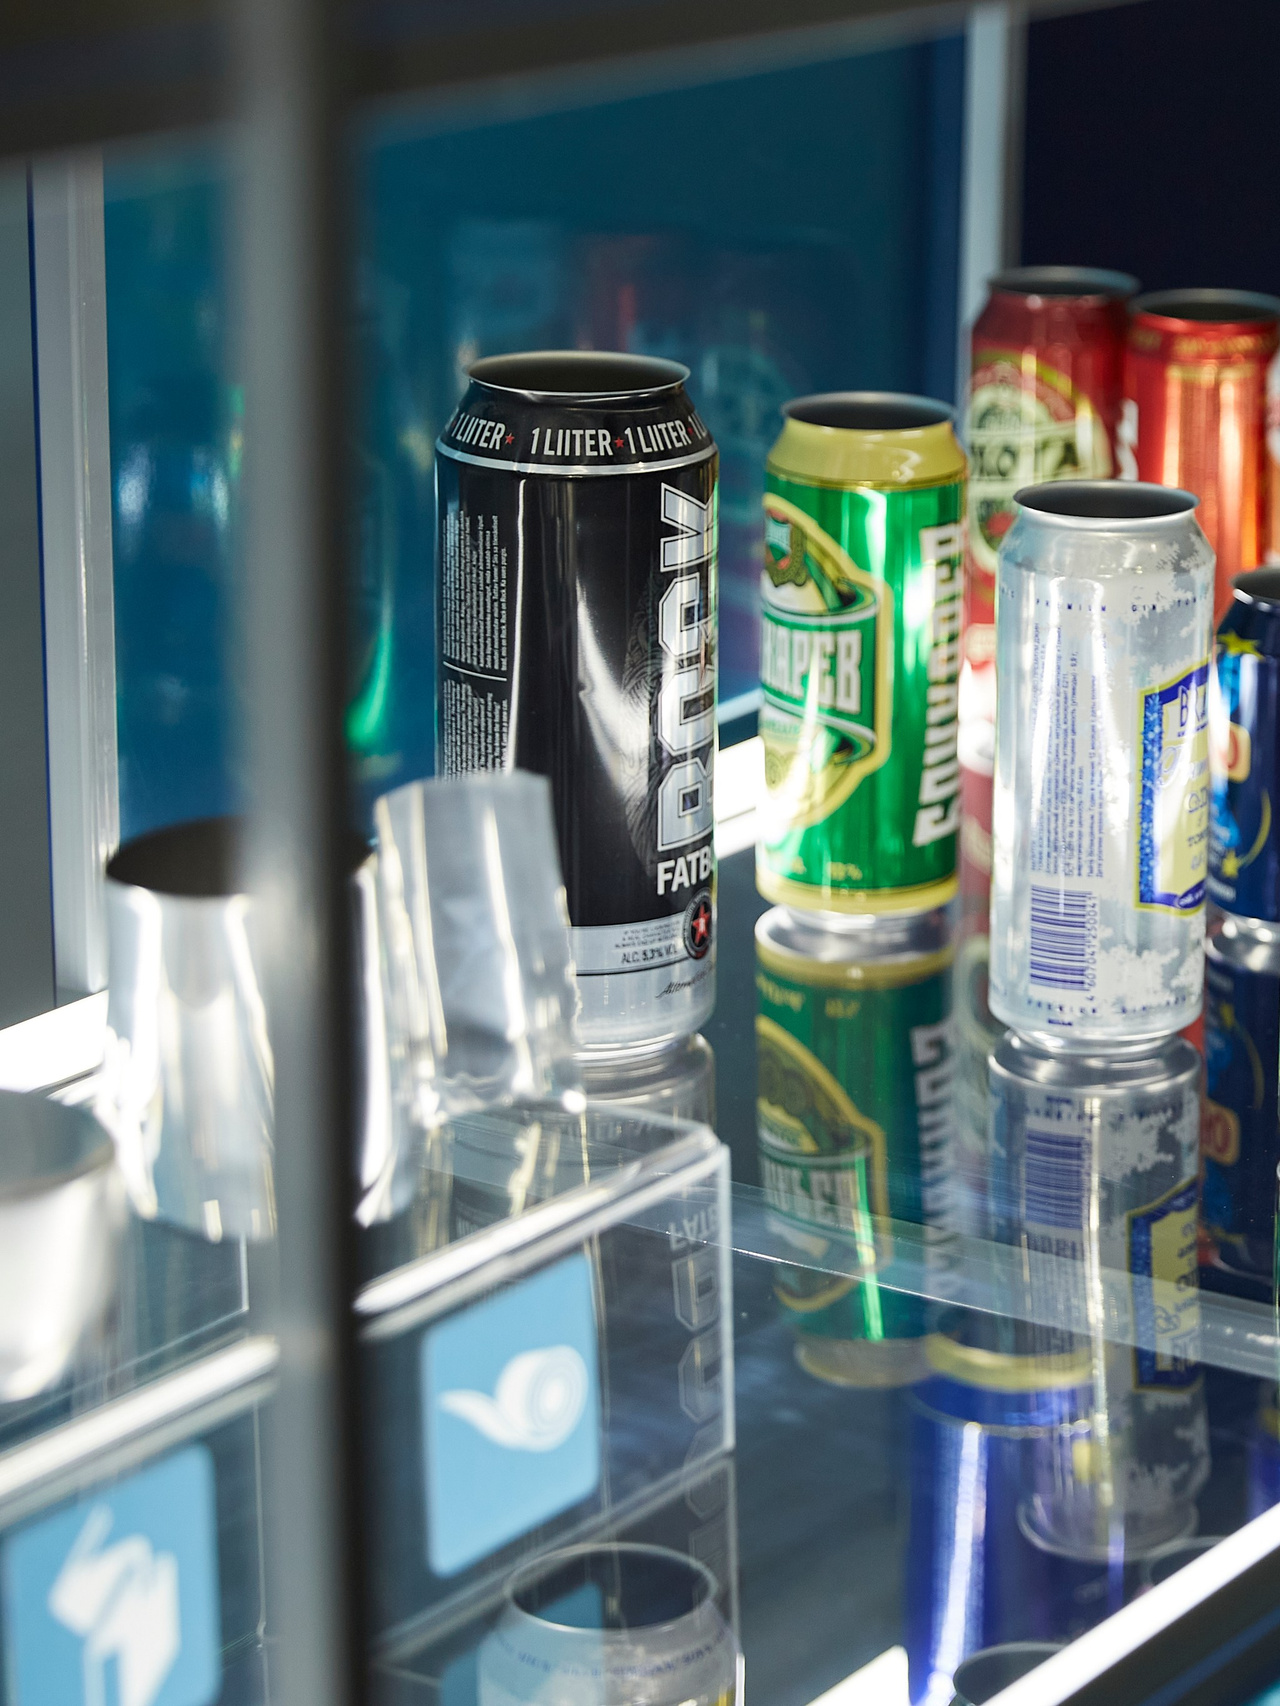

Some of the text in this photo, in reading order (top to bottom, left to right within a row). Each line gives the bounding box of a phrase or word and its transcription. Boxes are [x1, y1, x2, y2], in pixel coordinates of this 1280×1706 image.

[456, 415, 507, 450] LIITER
[531, 427, 613, 456] 1 LIITER
[624, 419, 692, 454] 1 LIITER
